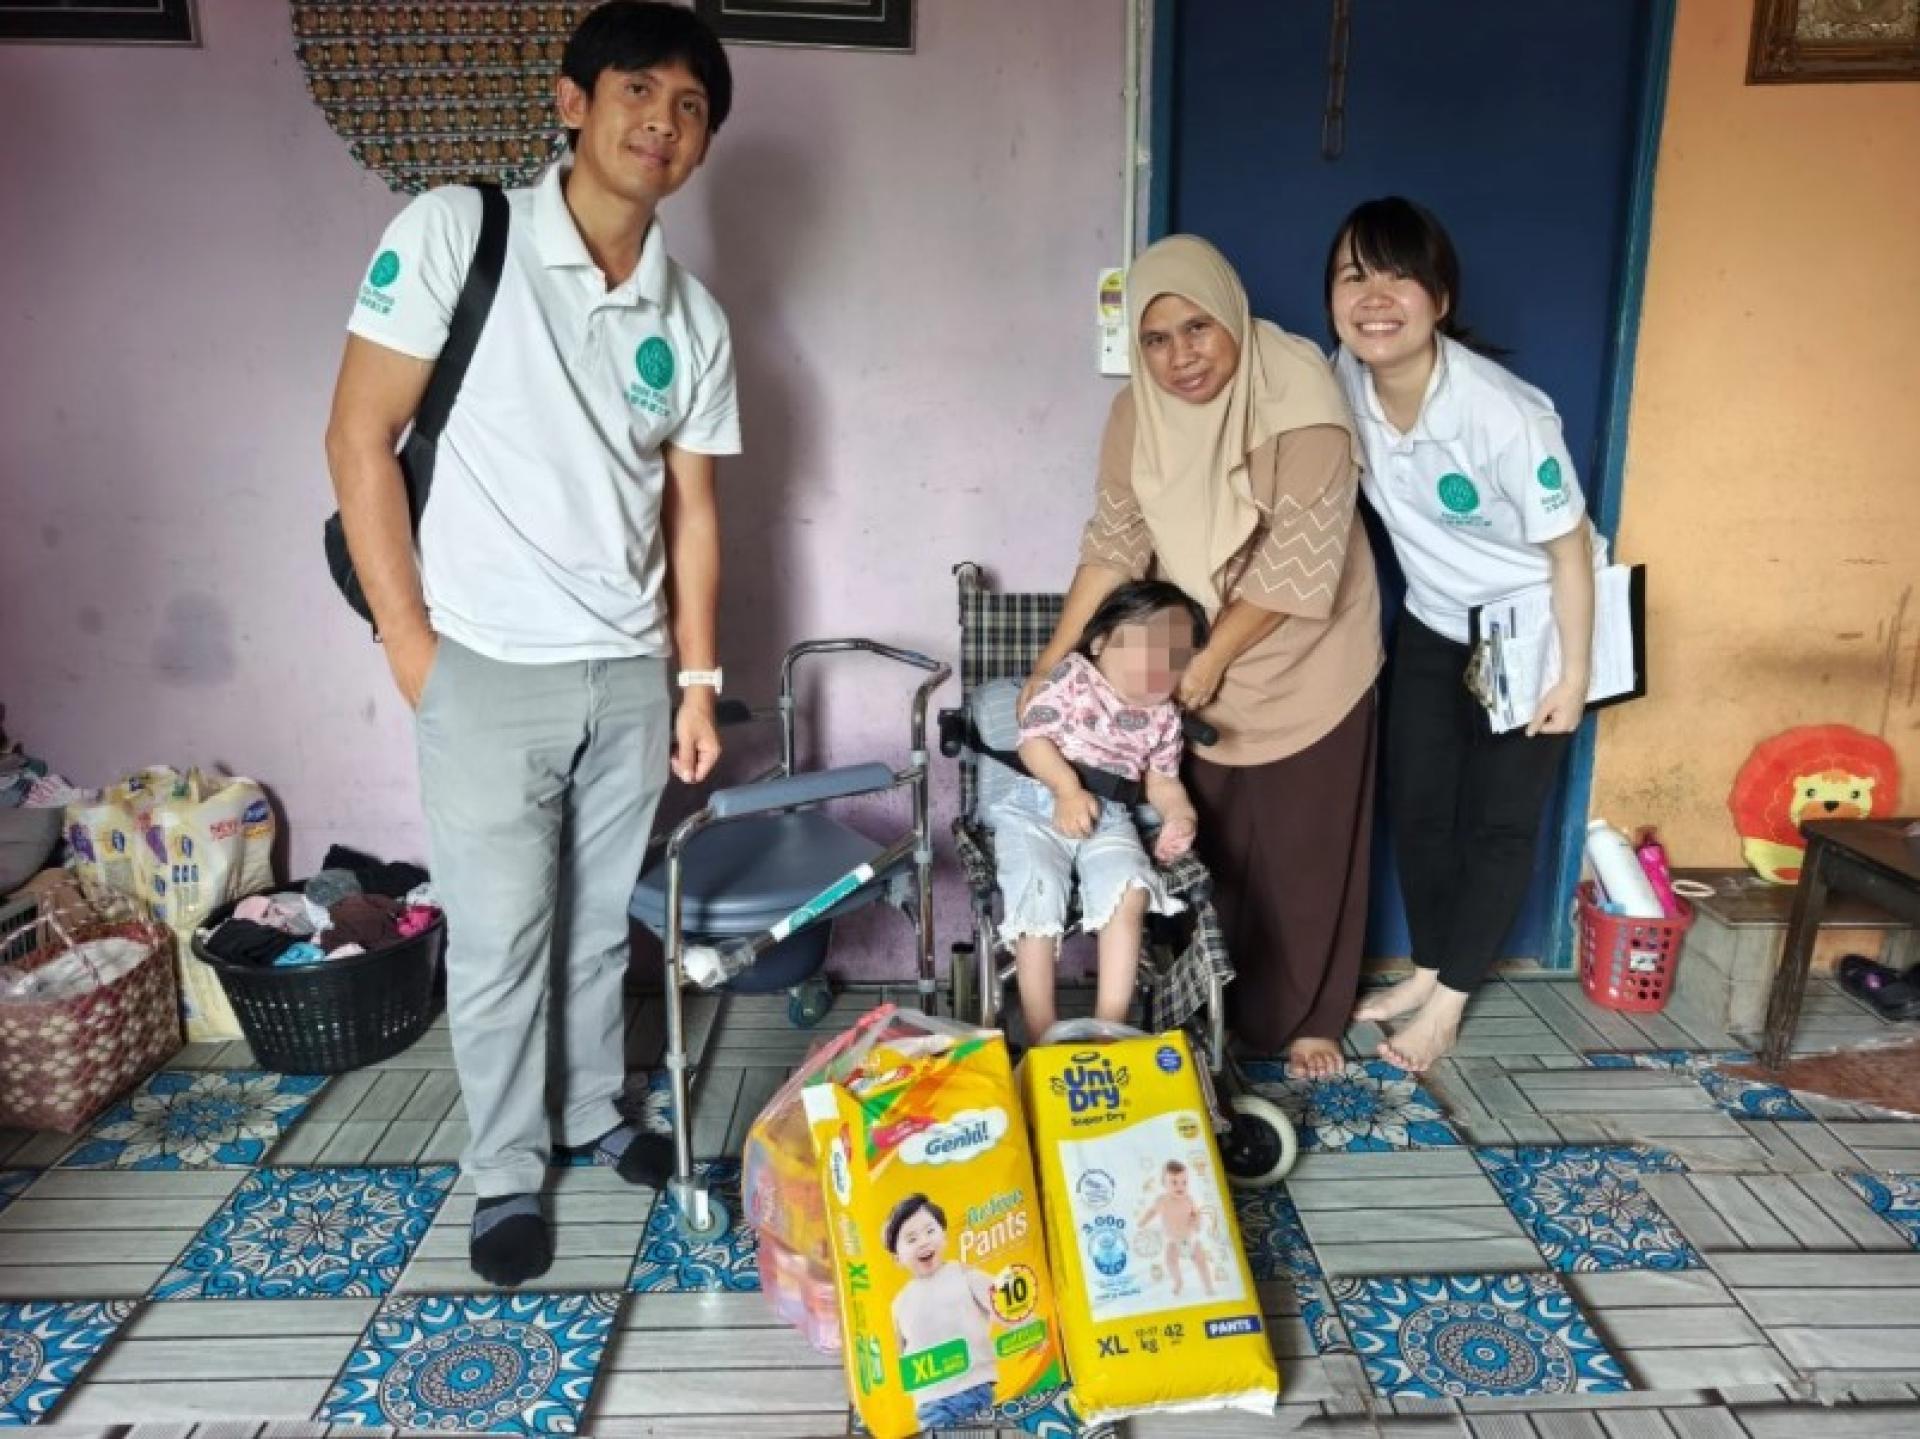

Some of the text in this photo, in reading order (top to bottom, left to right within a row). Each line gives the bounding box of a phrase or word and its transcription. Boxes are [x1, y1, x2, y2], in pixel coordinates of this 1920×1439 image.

[1064, 1058, 1115, 1088] Uni
[1069, 1084, 1120, 1113] Dry
[960, 1210, 1028, 1265] Pants
[999, 1275, 1027, 1306] 10
[1164, 1323, 1185, 1338] 42
[1097, 1335, 1130, 1358] XL
[911, 1352, 942, 1385] XL
